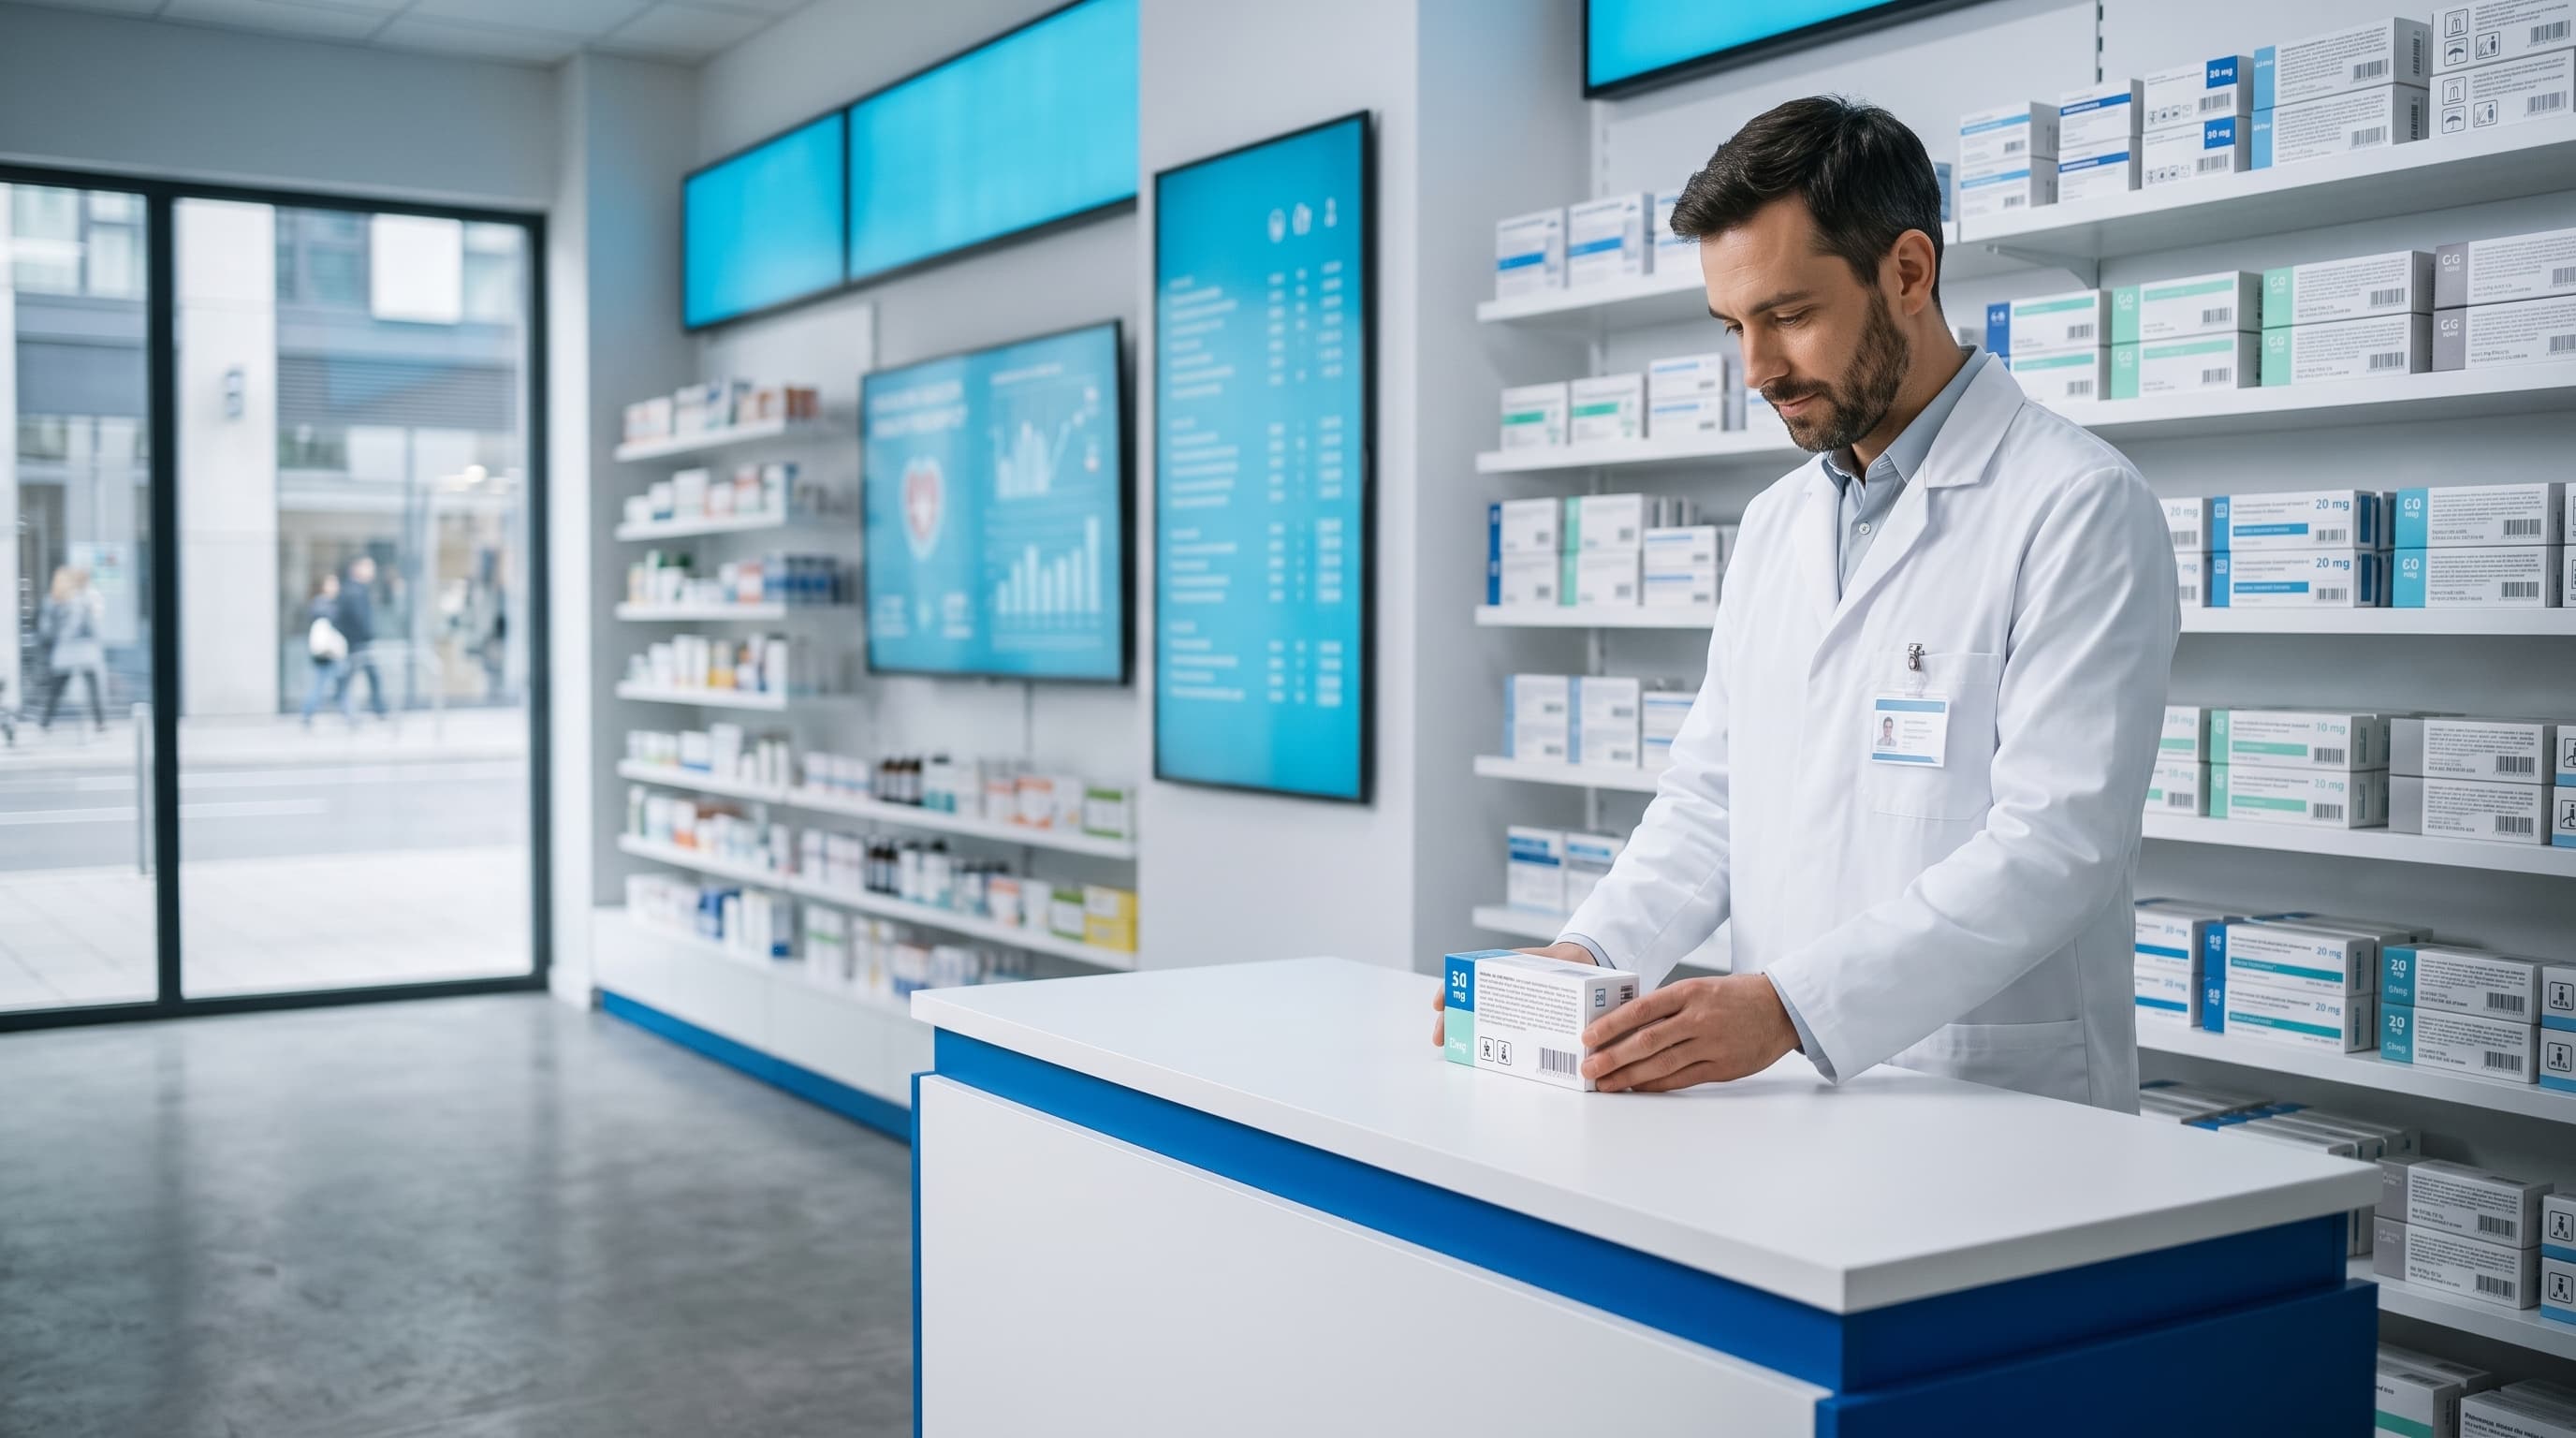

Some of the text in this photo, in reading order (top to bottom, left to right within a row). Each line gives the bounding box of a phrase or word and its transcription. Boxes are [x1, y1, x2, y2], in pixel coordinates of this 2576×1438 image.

[2316, 498, 2349, 511] 20 mg
[2183, 506, 2198, 519] mg
[2316, 557, 2350, 571] 20 mg
[2330, 724, 2346, 735] mg
[2328, 781, 2344, 793] mg
[2317, 946, 2328, 956] 20
[2391, 959, 2407, 972] 20
[1453, 990, 1467, 1003] mg
[2315, 1002, 2327, 1012] 20
[2389, 1015, 2406, 1028] 20
